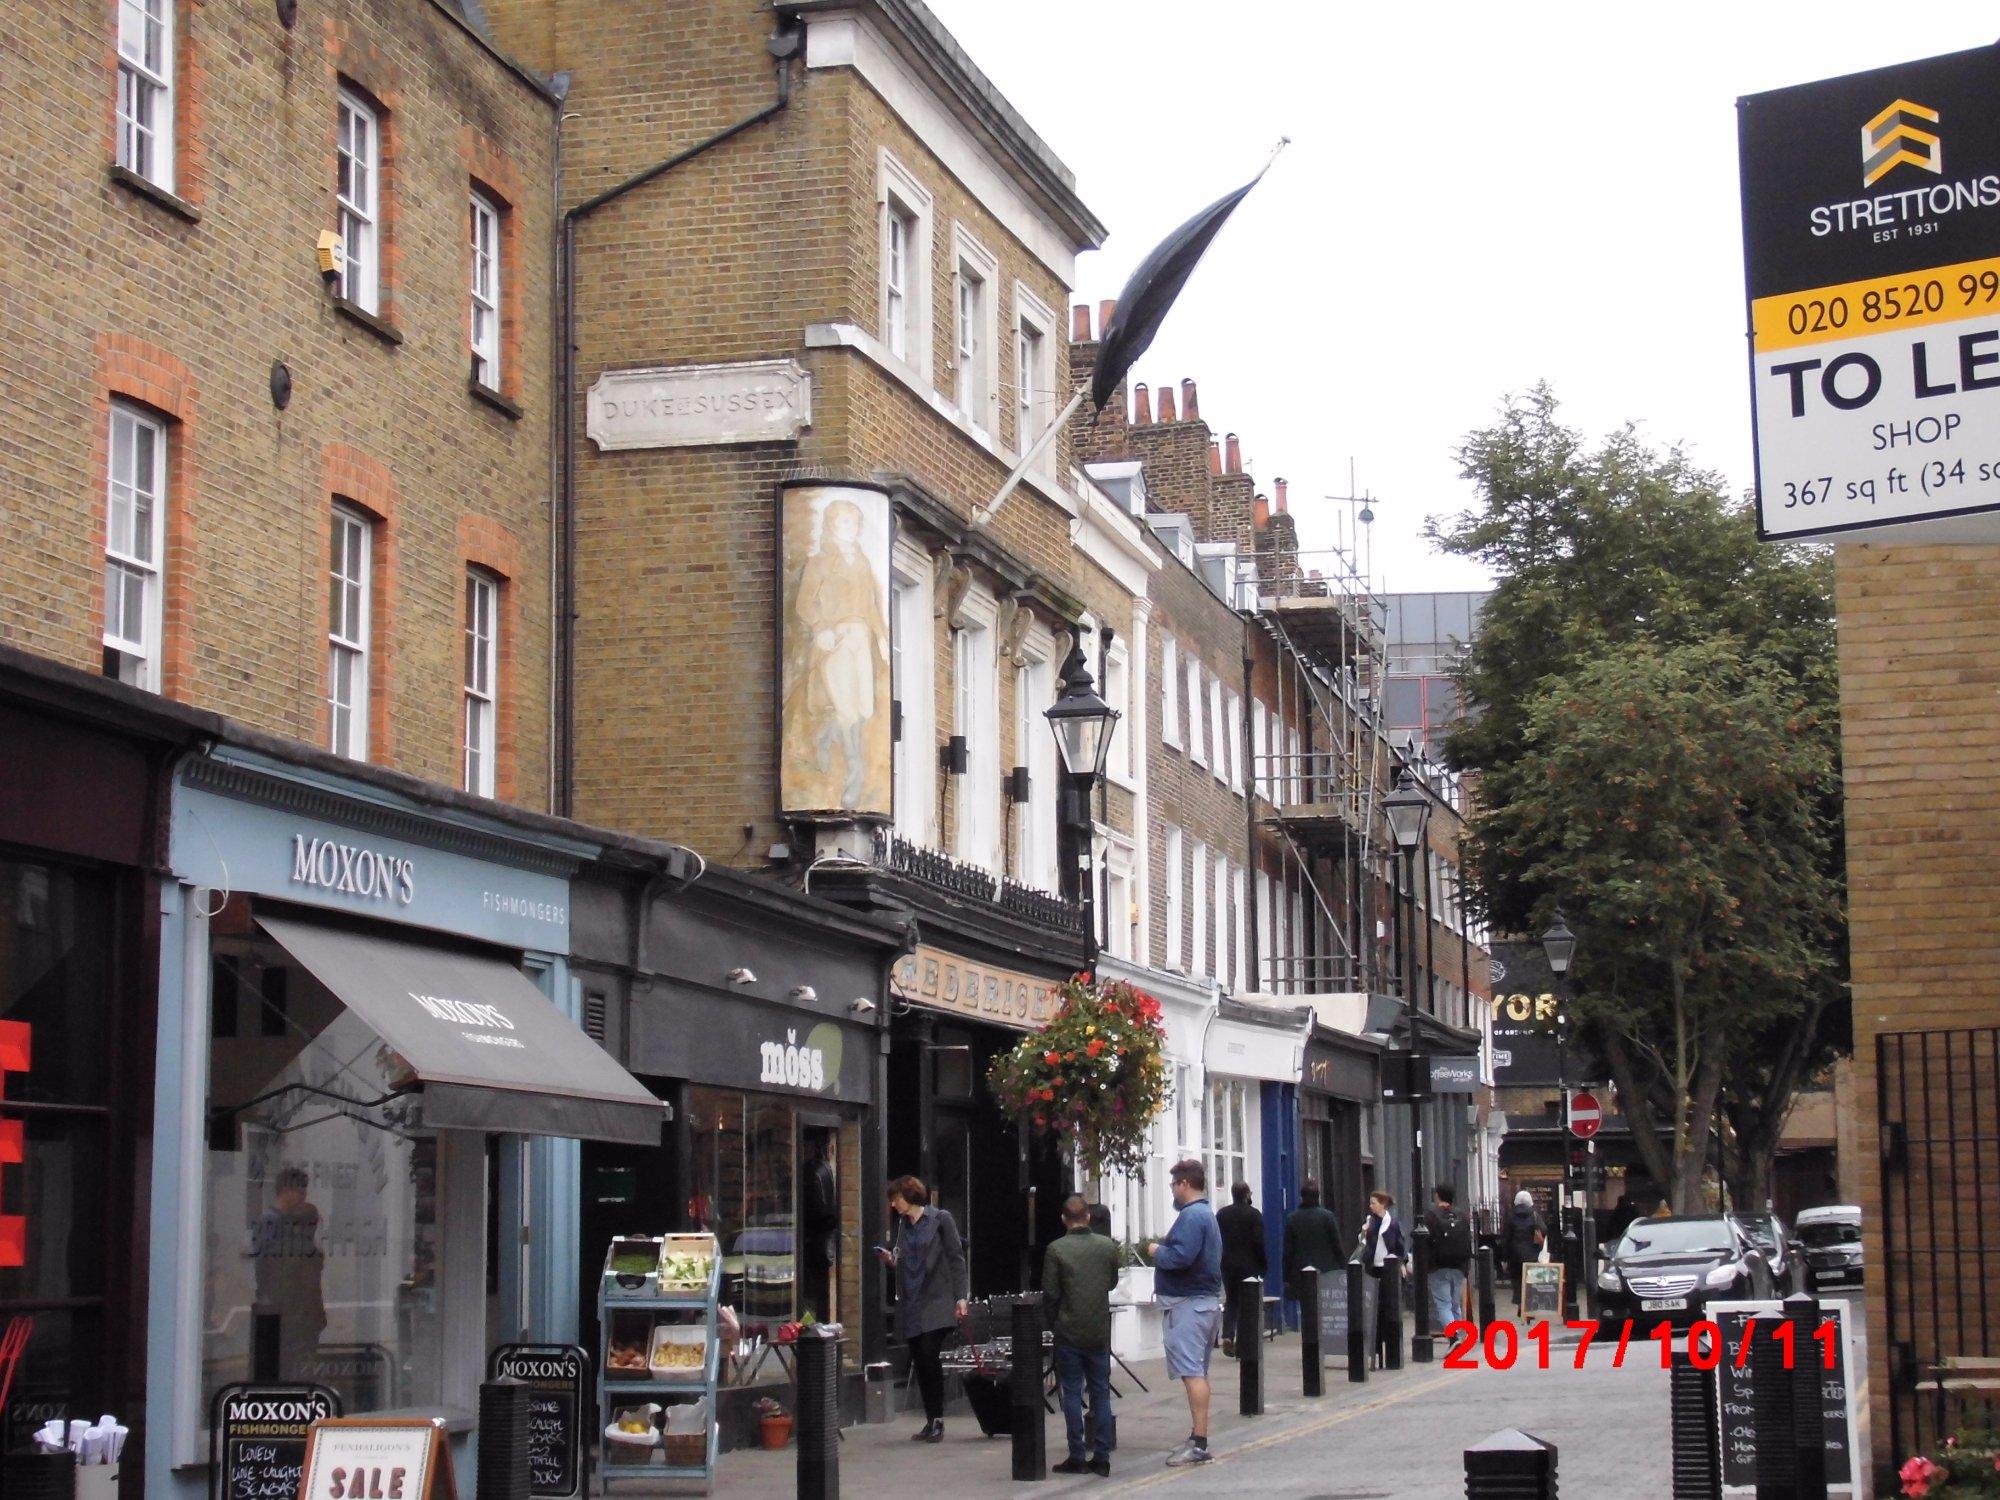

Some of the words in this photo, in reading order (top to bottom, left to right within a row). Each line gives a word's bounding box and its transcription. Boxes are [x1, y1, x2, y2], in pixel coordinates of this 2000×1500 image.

[1810, 177, 2000, 237] STRETTONS
[1873, 229, 1899, 243] EST
[1908, 222, 1939, 237] 1931
[1788, 297, 1848, 335] 020
[1862, 280, 1944, 323] 8520
[1770, 352, 1882, 418] TO
[603, 398, 675, 420] DUKE
[694, 391, 793, 415] SUSSEX
[1872, 413, 1961, 450] SHOP
[1784, 477, 1833, 508] 367
[1846, 480, 1875, 504] sq
[1887, 467, 1908, 494] ft
[1921, 458, 1965, 497] (34
[292, 833, 415, 905] MOXON'S
[482, 891, 566, 926] FISHMONGERS
[503, 1361, 577, 1378] MOXON'S
[229, 1402, 326, 1420] MOXON'S
[229, 1424, 309, 1435] FISHMONGE
[235, 1480, 300, 1498] SEABAS
[329, 1467, 406, 1499] SALE
